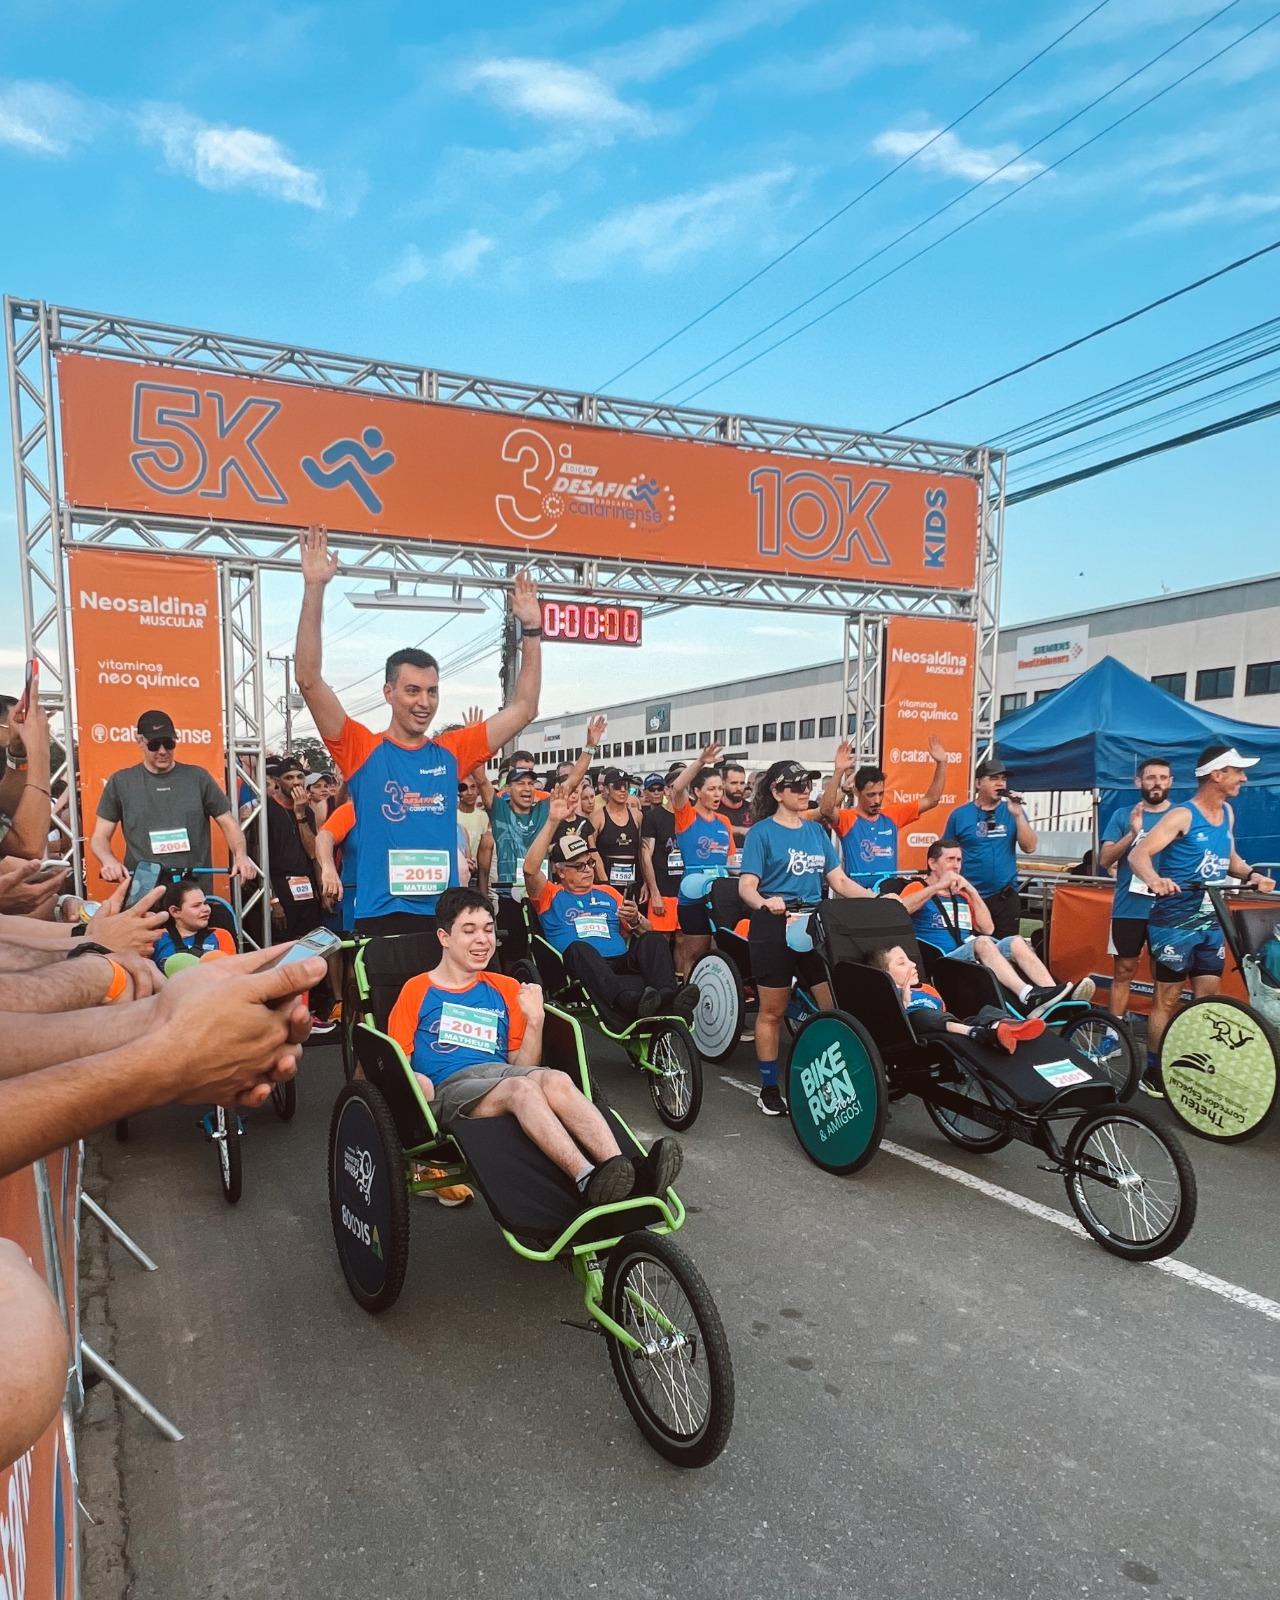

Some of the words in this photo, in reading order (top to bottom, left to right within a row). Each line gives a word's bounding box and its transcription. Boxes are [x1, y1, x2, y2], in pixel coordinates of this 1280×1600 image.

[130, 380, 289, 505] 5K
[569, 502, 662, 523] catarinense
[748, 466, 892, 567] 10K
[923, 486, 948, 568] KIDS
[79, 591, 208, 618] Neosaldina
[139, 615, 205, 629] MUSCULAR
[97, 660, 163, 672] vitaminas
[891, 648, 967, 667] Neosaldina
[97, 672, 132, 686] neo
[135, 671, 200, 690] química
[926, 666, 964, 676] MUSCULAR
[898, 700, 938, 709] vitaminas
[897, 709, 918, 720] neo
[920, 708, 959, 722] química
[109, 724, 212, 745] catense
[159, 841, 188, 852] 2004
[909, 833, 937, 845] CIMED
[405, 868, 443, 881] 2015
[403, 883, 437, 892] MATEUS
[451, 1020, 493, 1040] 2011
[444, 1033, 490, 1049] MATHEUS
[800, 1040, 847, 1099] BIKE
[807, 1068, 857, 1126] RUN
[1168, 1075, 1203, 1102] Especial
[826, 1099, 863, 1136] AMIGOS!
[1204, 1096, 1246, 1125] Corredor
[341, 1204, 371, 1246] SICOOB
